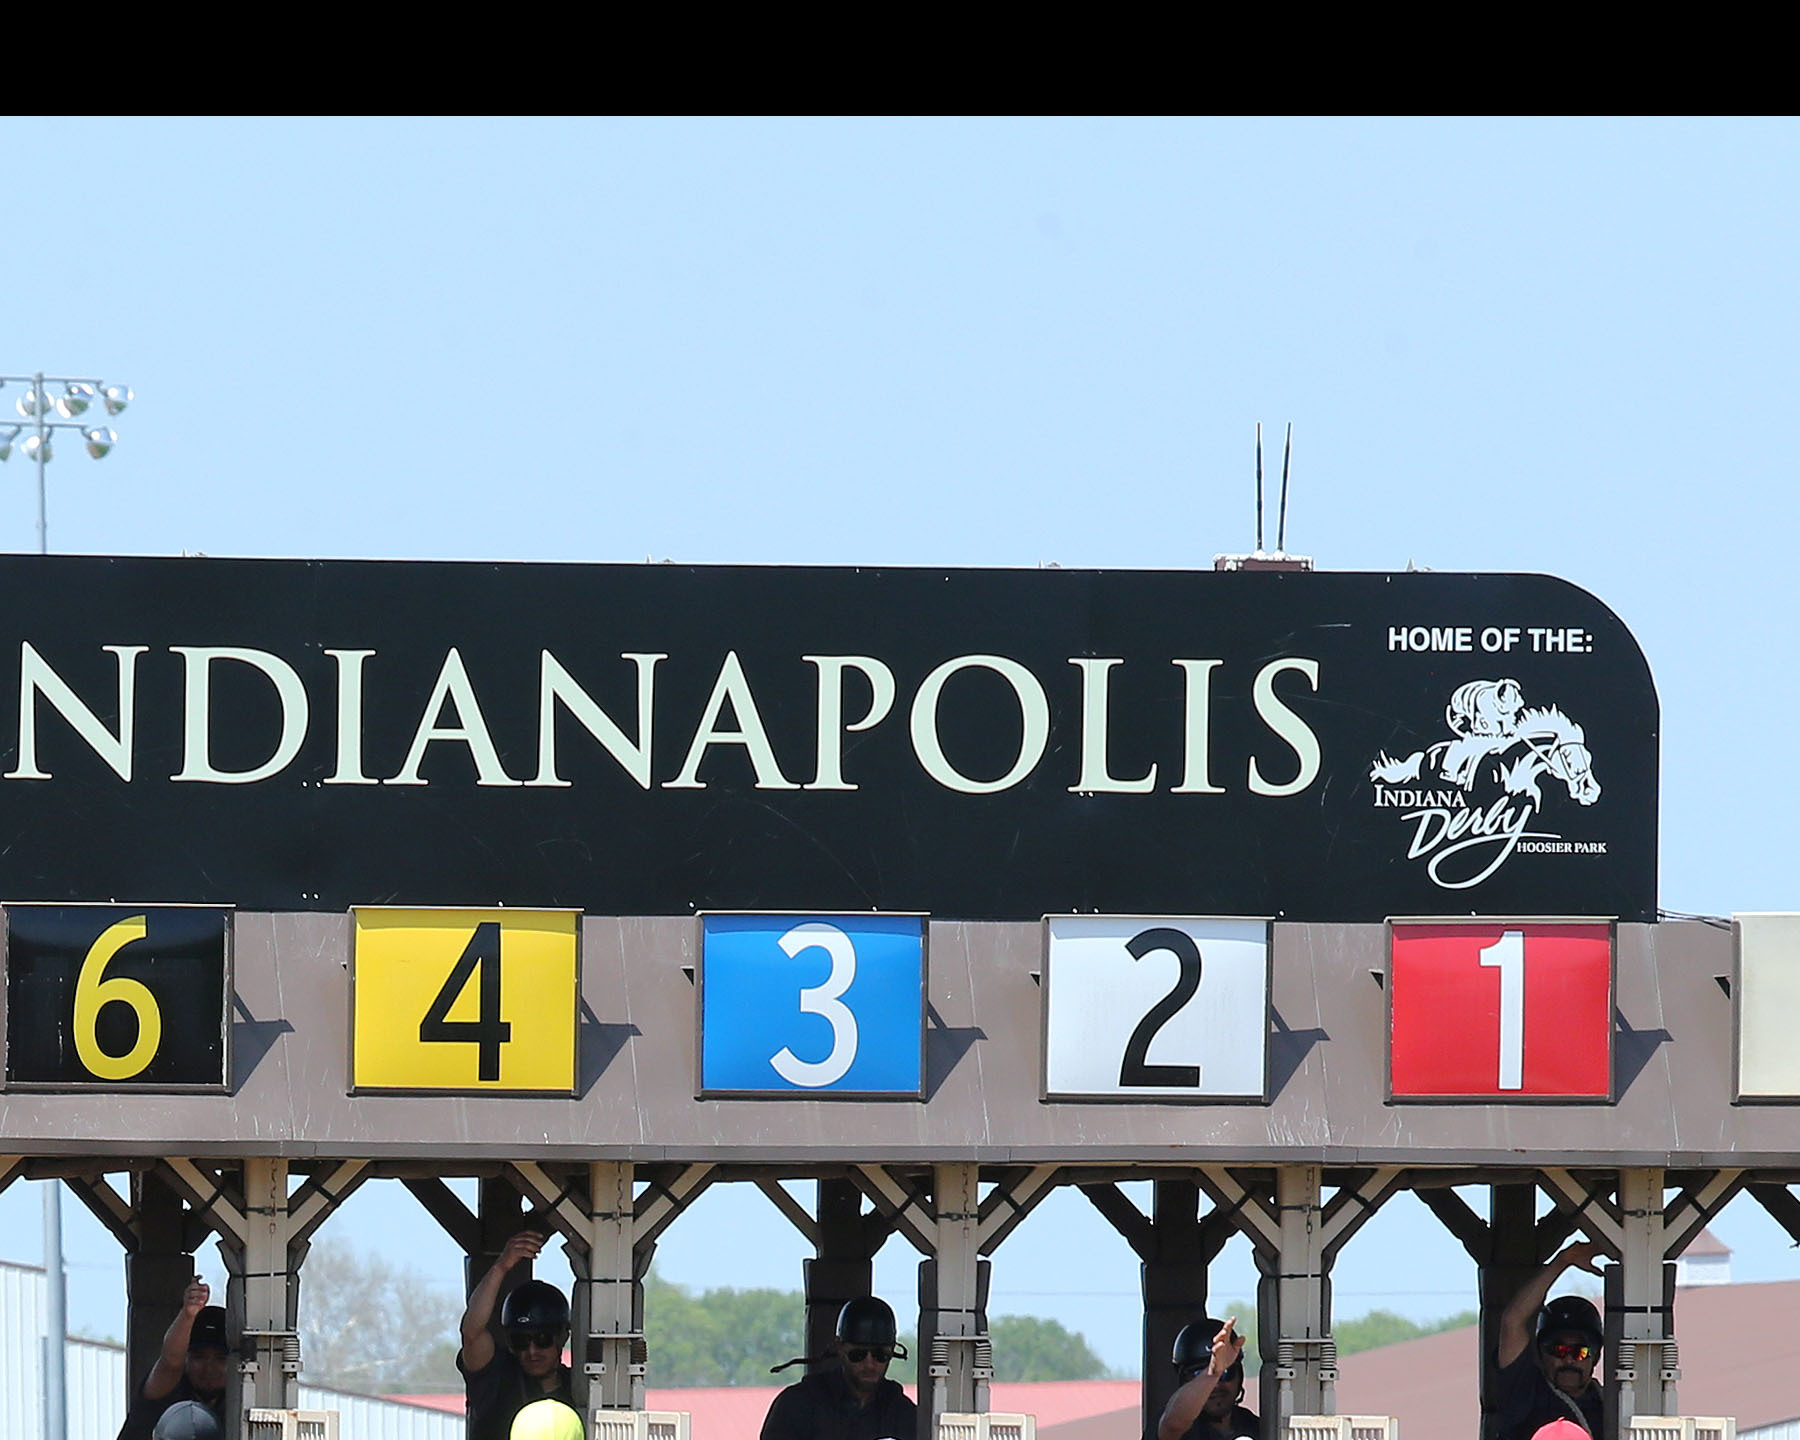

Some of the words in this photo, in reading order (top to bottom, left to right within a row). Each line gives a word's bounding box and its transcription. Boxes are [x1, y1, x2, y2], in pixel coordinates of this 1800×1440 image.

[1388, 626, 1472, 652] HOME
[1480, 627, 1521, 652] OF
[1527, 628, 1593, 653] THE:
[1373, 784, 1467, 808] INDIANA
[1400, 795, 1562, 889] Derby
[1516, 842, 1573, 854] HOOSIER
[1574, 842, 1608, 854] PARK
[73, 917, 162, 1081] 6
[419, 921, 511, 1082] 4
[770, 926, 859, 1089] 3
[1120, 927, 1205, 1088] 2
[1479, 931, 1524, 1090] 1
